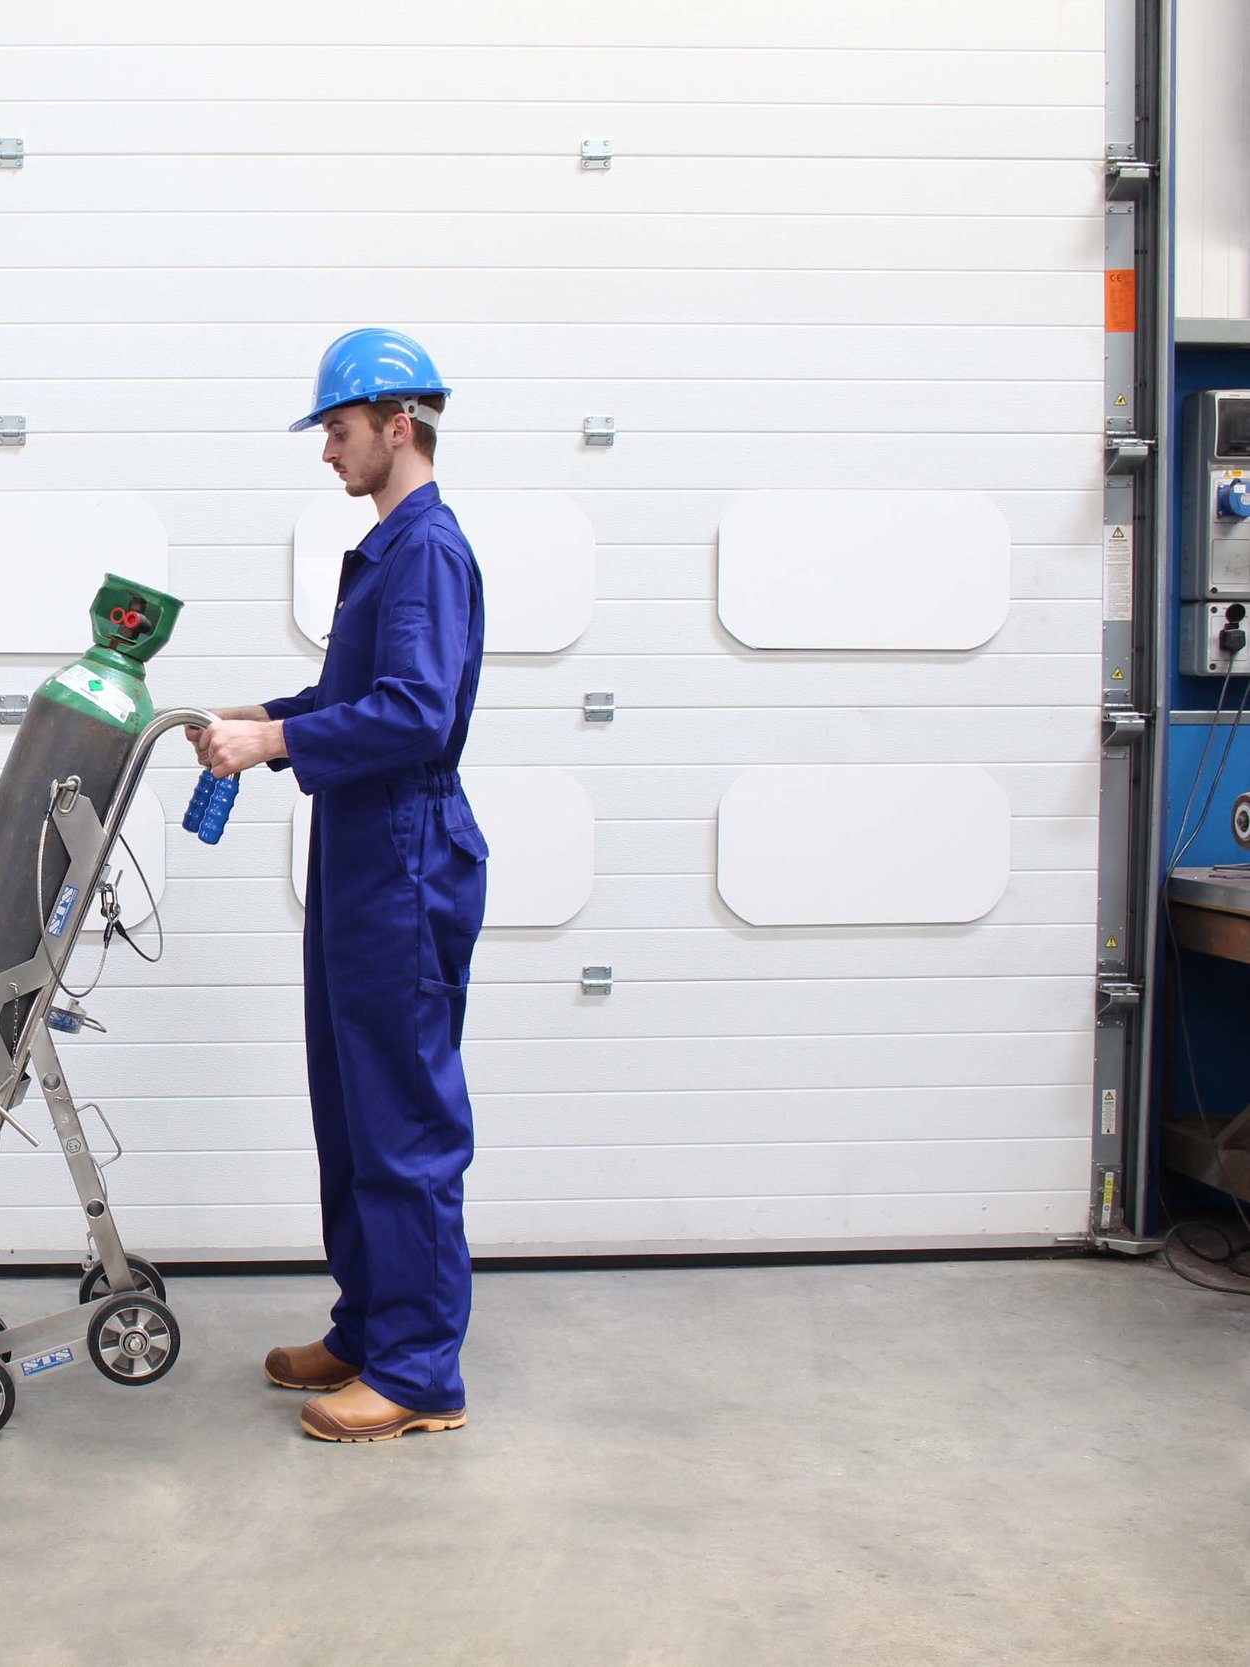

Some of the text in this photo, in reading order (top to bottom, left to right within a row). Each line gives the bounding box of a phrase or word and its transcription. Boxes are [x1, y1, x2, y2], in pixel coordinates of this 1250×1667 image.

[1109, 273, 1123, 283] CE
[48, 886, 74, 935] STS
[68, 1142, 79, 1151] Ex
[22, 1349, 71, 1371] STS
